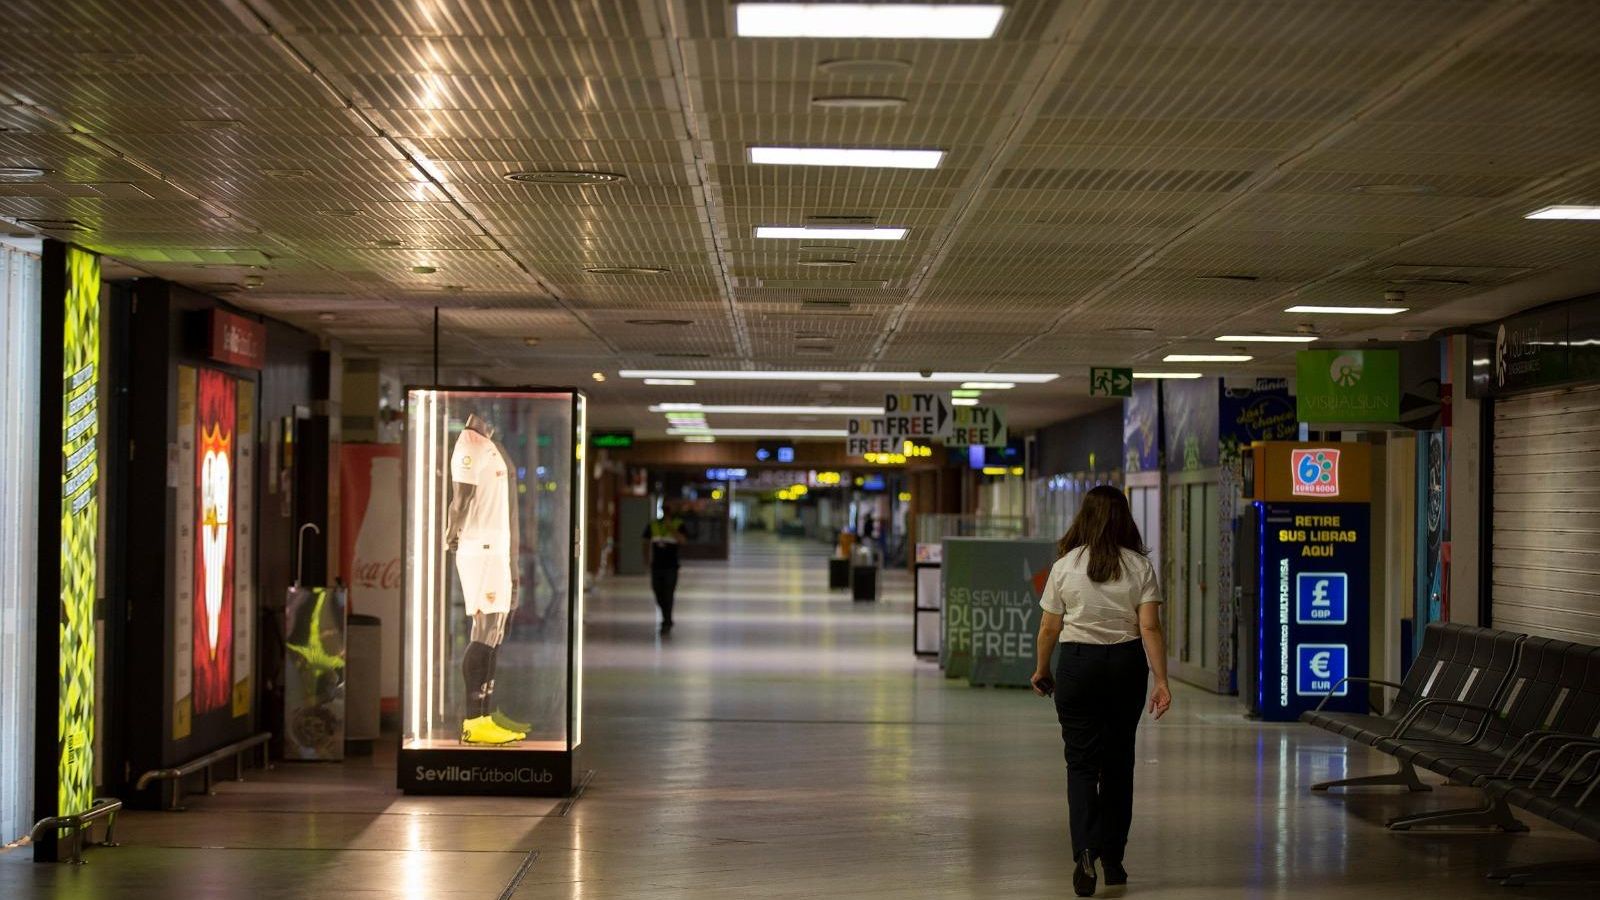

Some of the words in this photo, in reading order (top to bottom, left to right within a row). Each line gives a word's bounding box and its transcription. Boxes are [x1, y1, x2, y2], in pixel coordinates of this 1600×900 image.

[885, 394, 934, 412] DUTY
[848, 419, 885, 434] DUT
[886, 417, 934, 434] FREE
[849, 438, 889, 453] FREE
[1295, 516, 1341, 528] RETIRE
[1279, 530, 1306, 542] SUS
[1310, 531, 1357, 543] LIBRAS
[1301, 543, 1334, 557] AQUÍ
[1280, 557, 1289, 624] MULTI-DIVISA
[972, 590, 1033, 607] SEVILLA
[972, 608, 1033, 631] DUTY
[1311, 609, 1331, 619] GBP
[972, 632, 1034, 658] FREE
[1311, 681, 1331, 691] EUR
